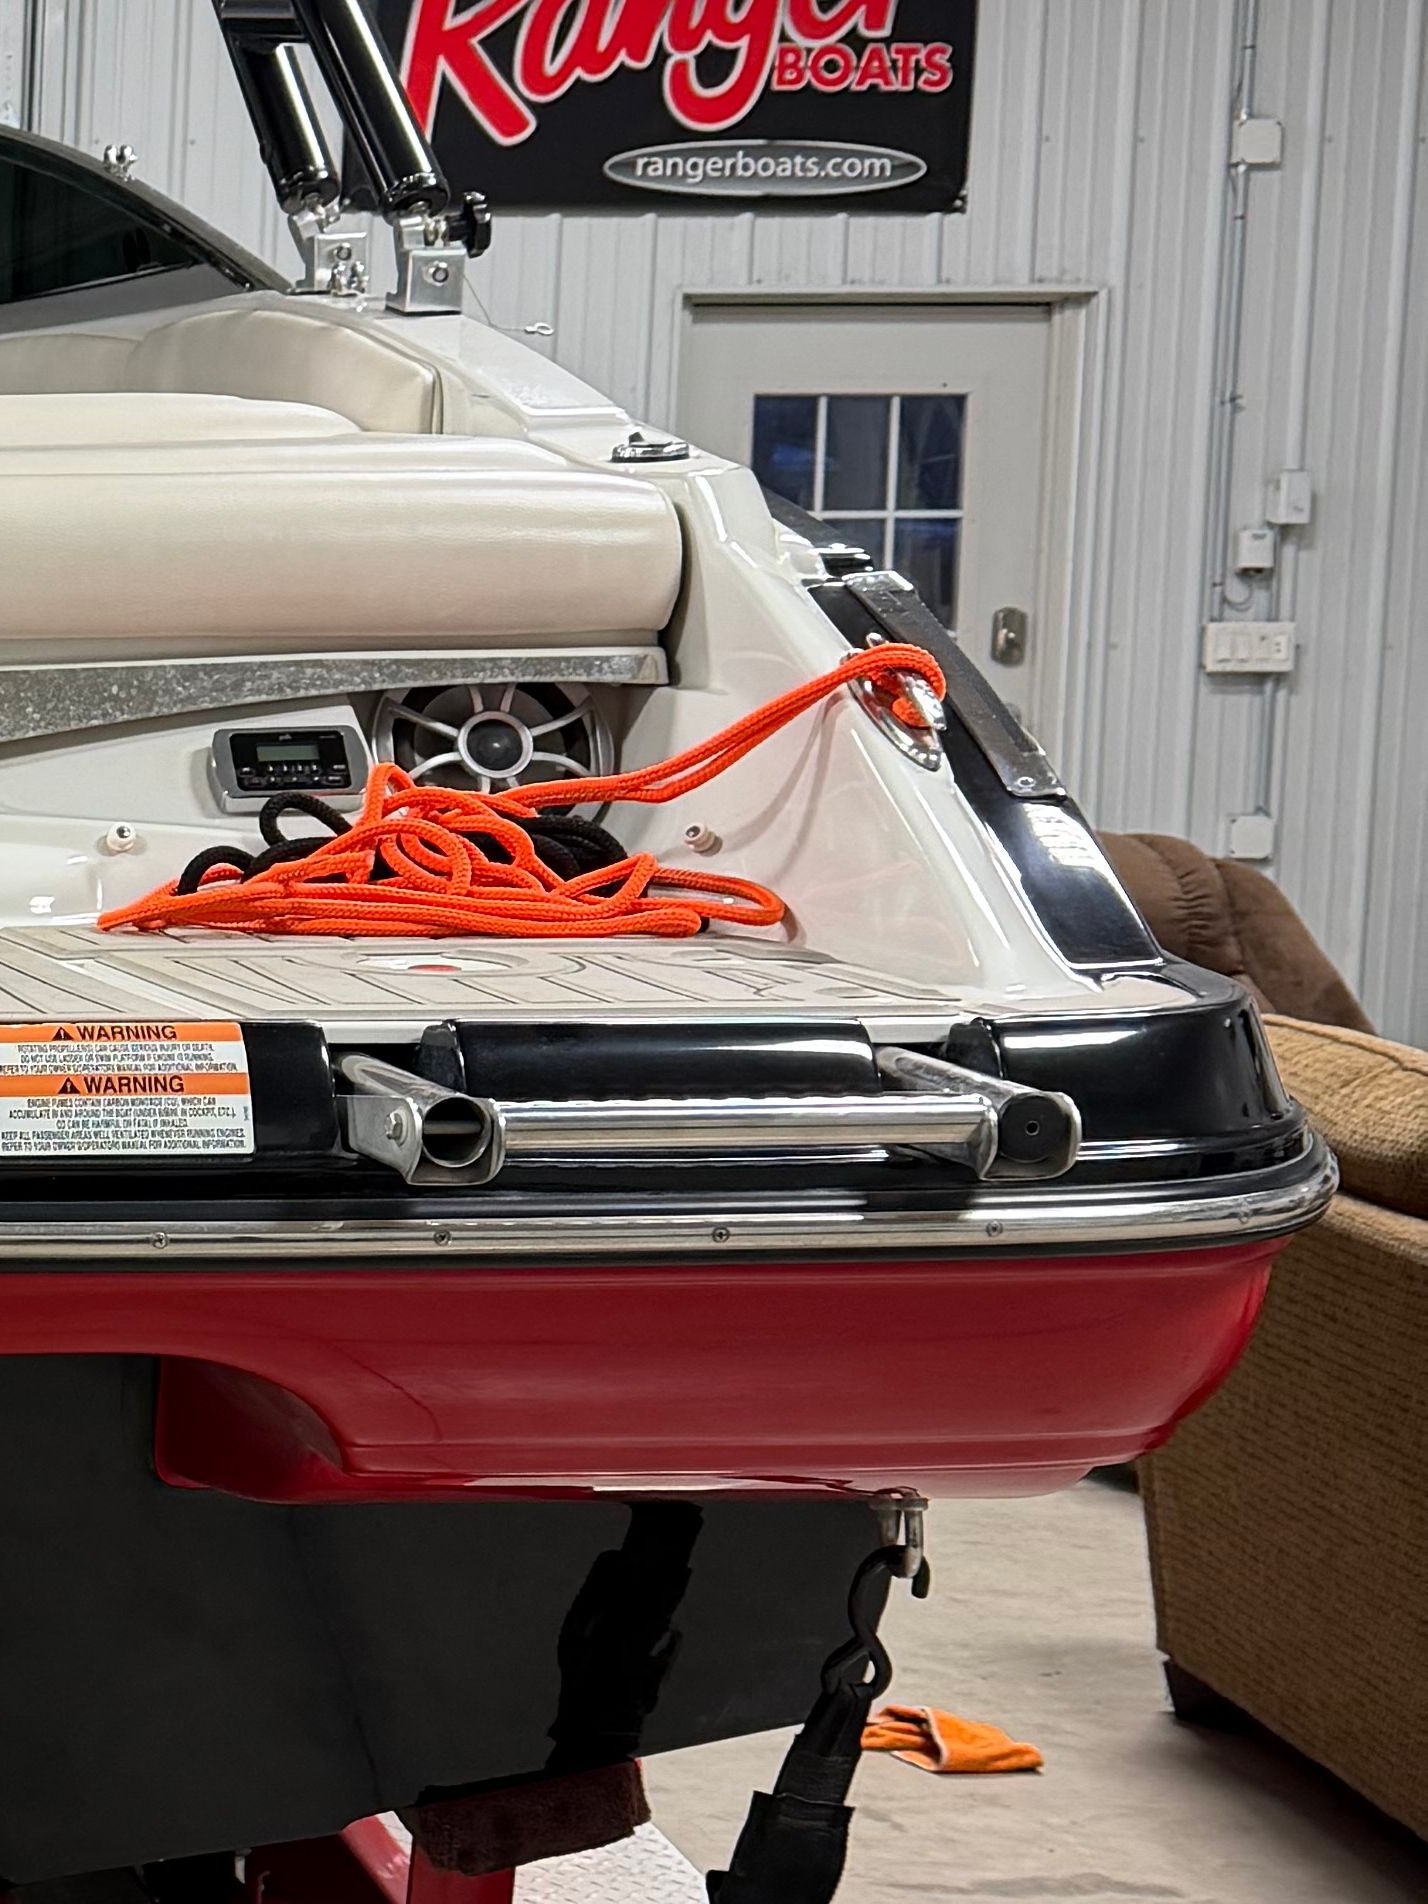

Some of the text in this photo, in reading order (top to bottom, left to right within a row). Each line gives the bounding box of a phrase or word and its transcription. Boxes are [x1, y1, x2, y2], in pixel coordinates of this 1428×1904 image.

[771, 43, 953, 92] BOATS
[635, 150, 892, 183] rangerboats.com
[76, 1025, 177, 1040] WARNING
[84, 1075, 185, 1093] WARNING
